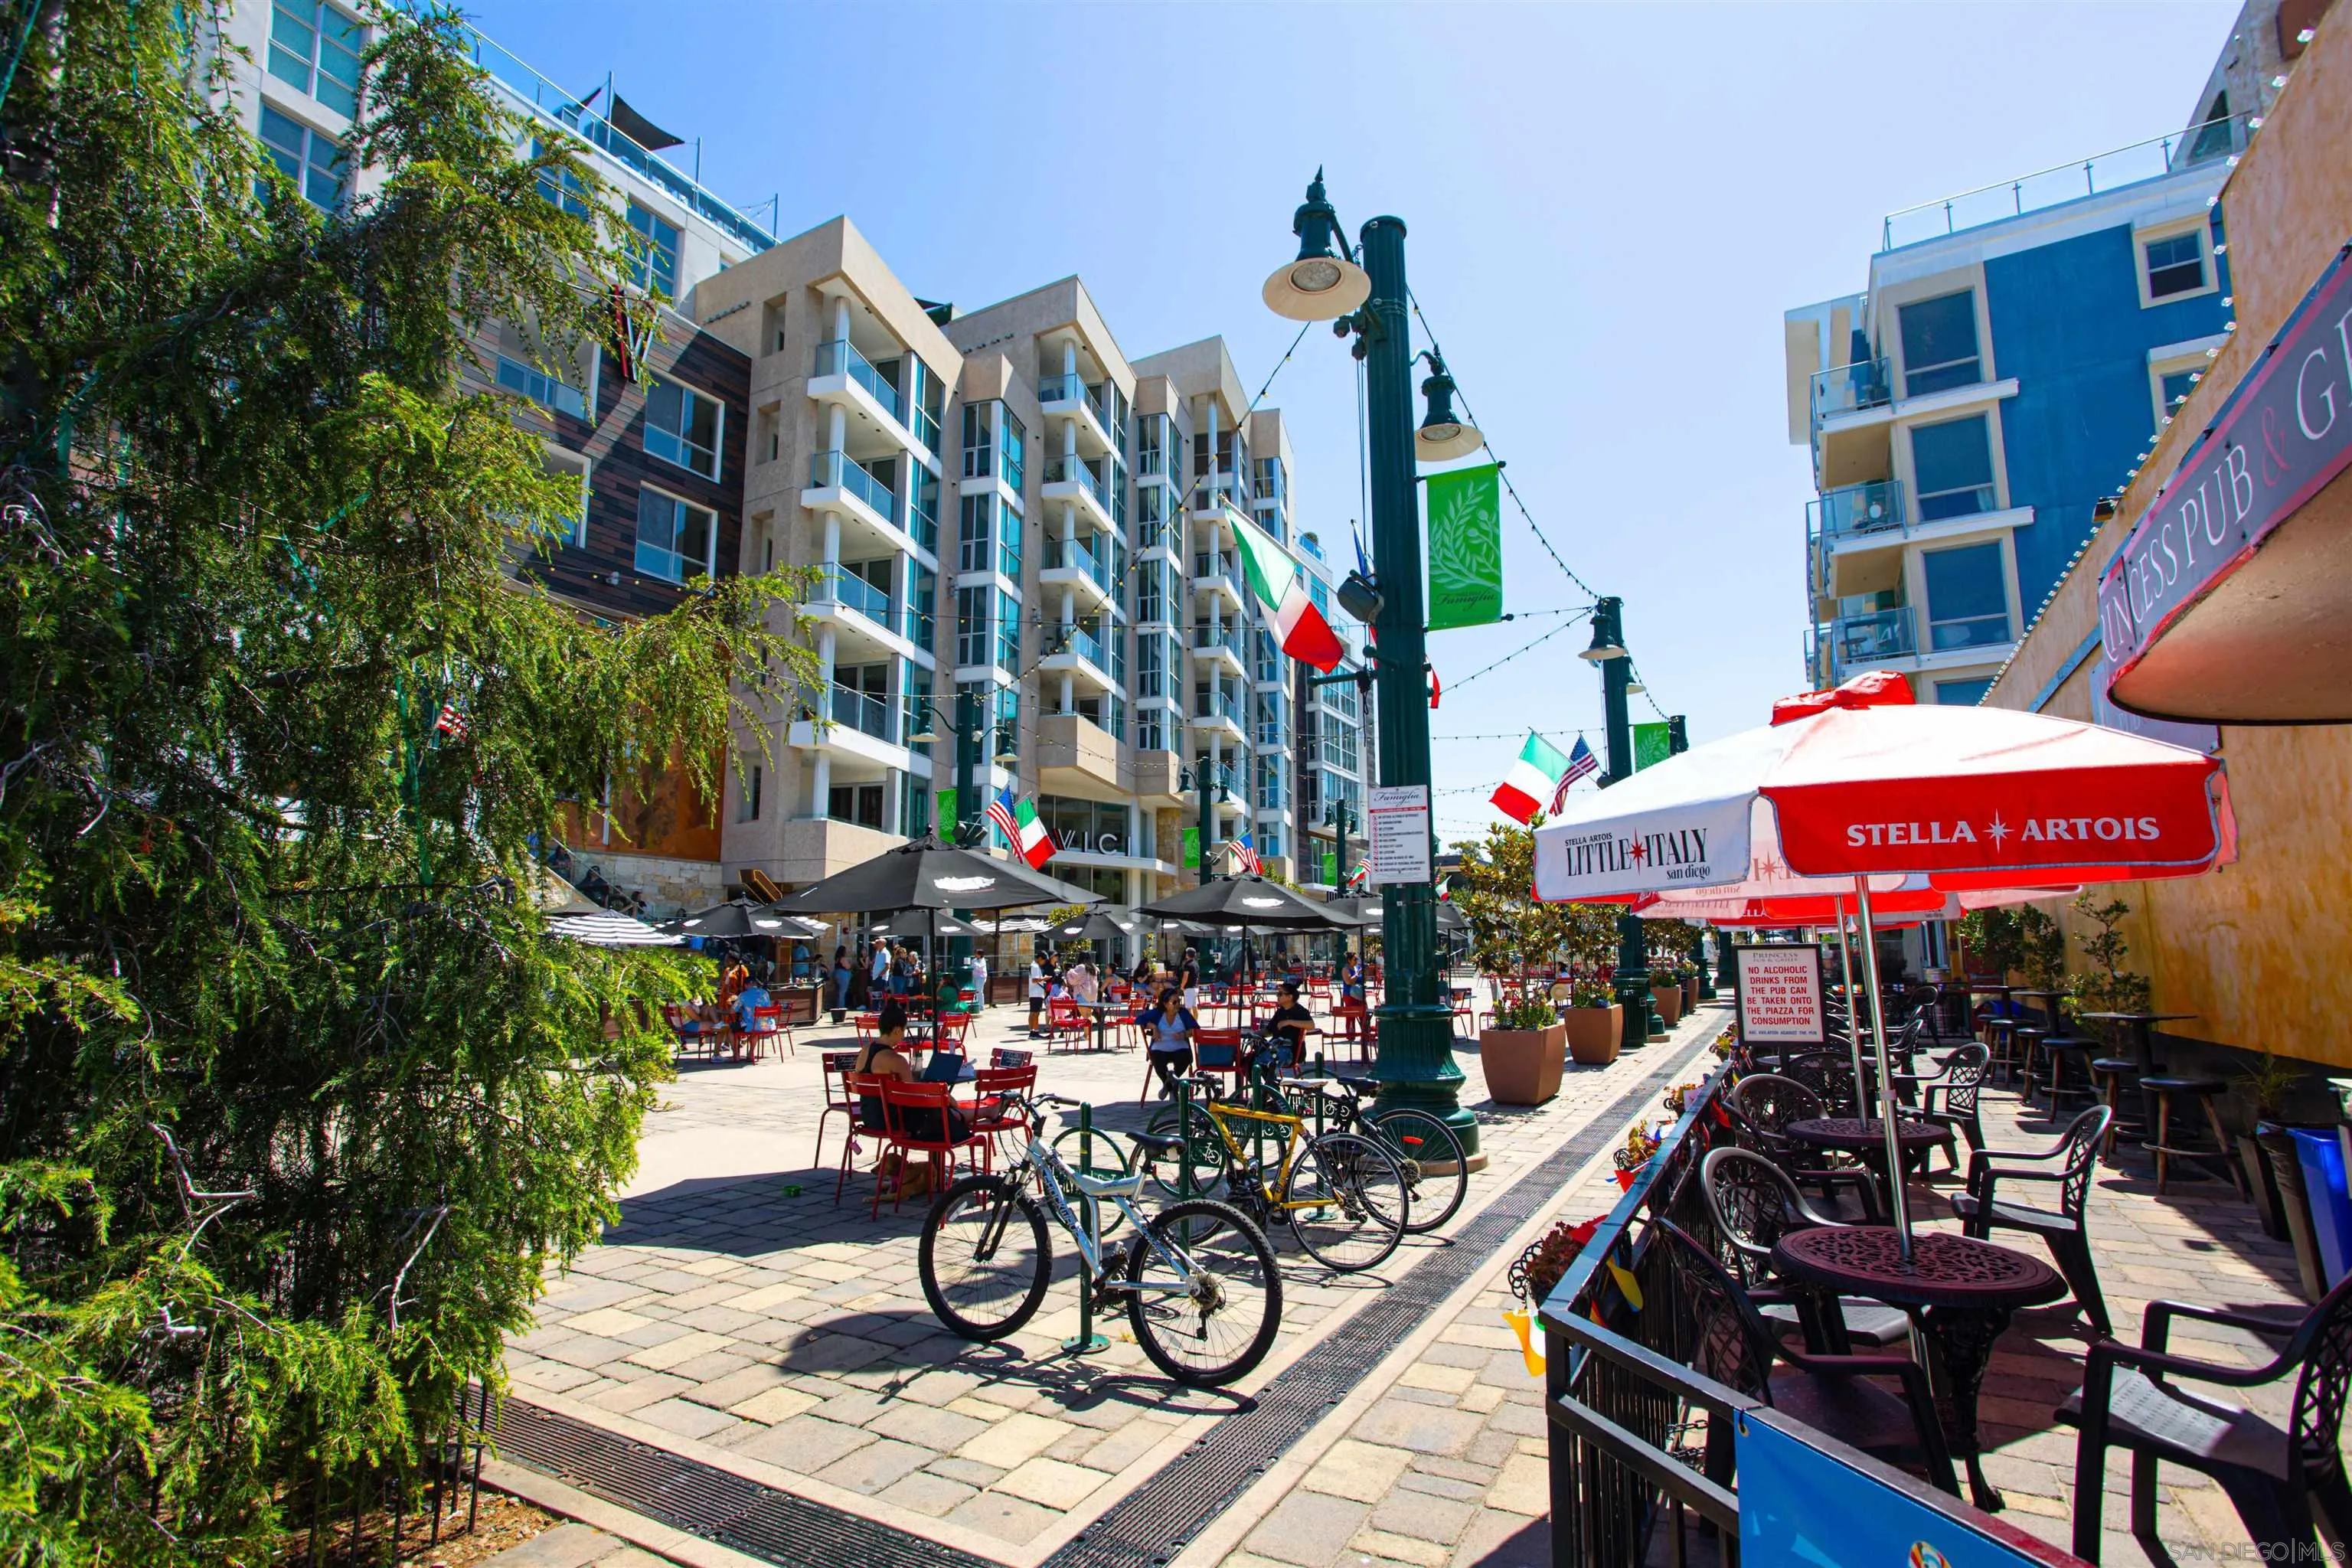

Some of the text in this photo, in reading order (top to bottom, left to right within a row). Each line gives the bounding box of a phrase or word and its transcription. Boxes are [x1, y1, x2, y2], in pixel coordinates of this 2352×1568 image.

[2180, 444, 2254, 569] PUB
[2262, 407, 2291, 488] &
[1374, 789, 1421, 807] Famiglia
[1053, 828, 1132, 857] VICI
[1564, 832, 1613, 846] STELLA ARTOIS
[1847, 817, 2161, 847] STELLA ARTOIS
[1566, 828, 1708, 877] LITTLE ITALY
[1667, 864, 1711, 880] san diego
